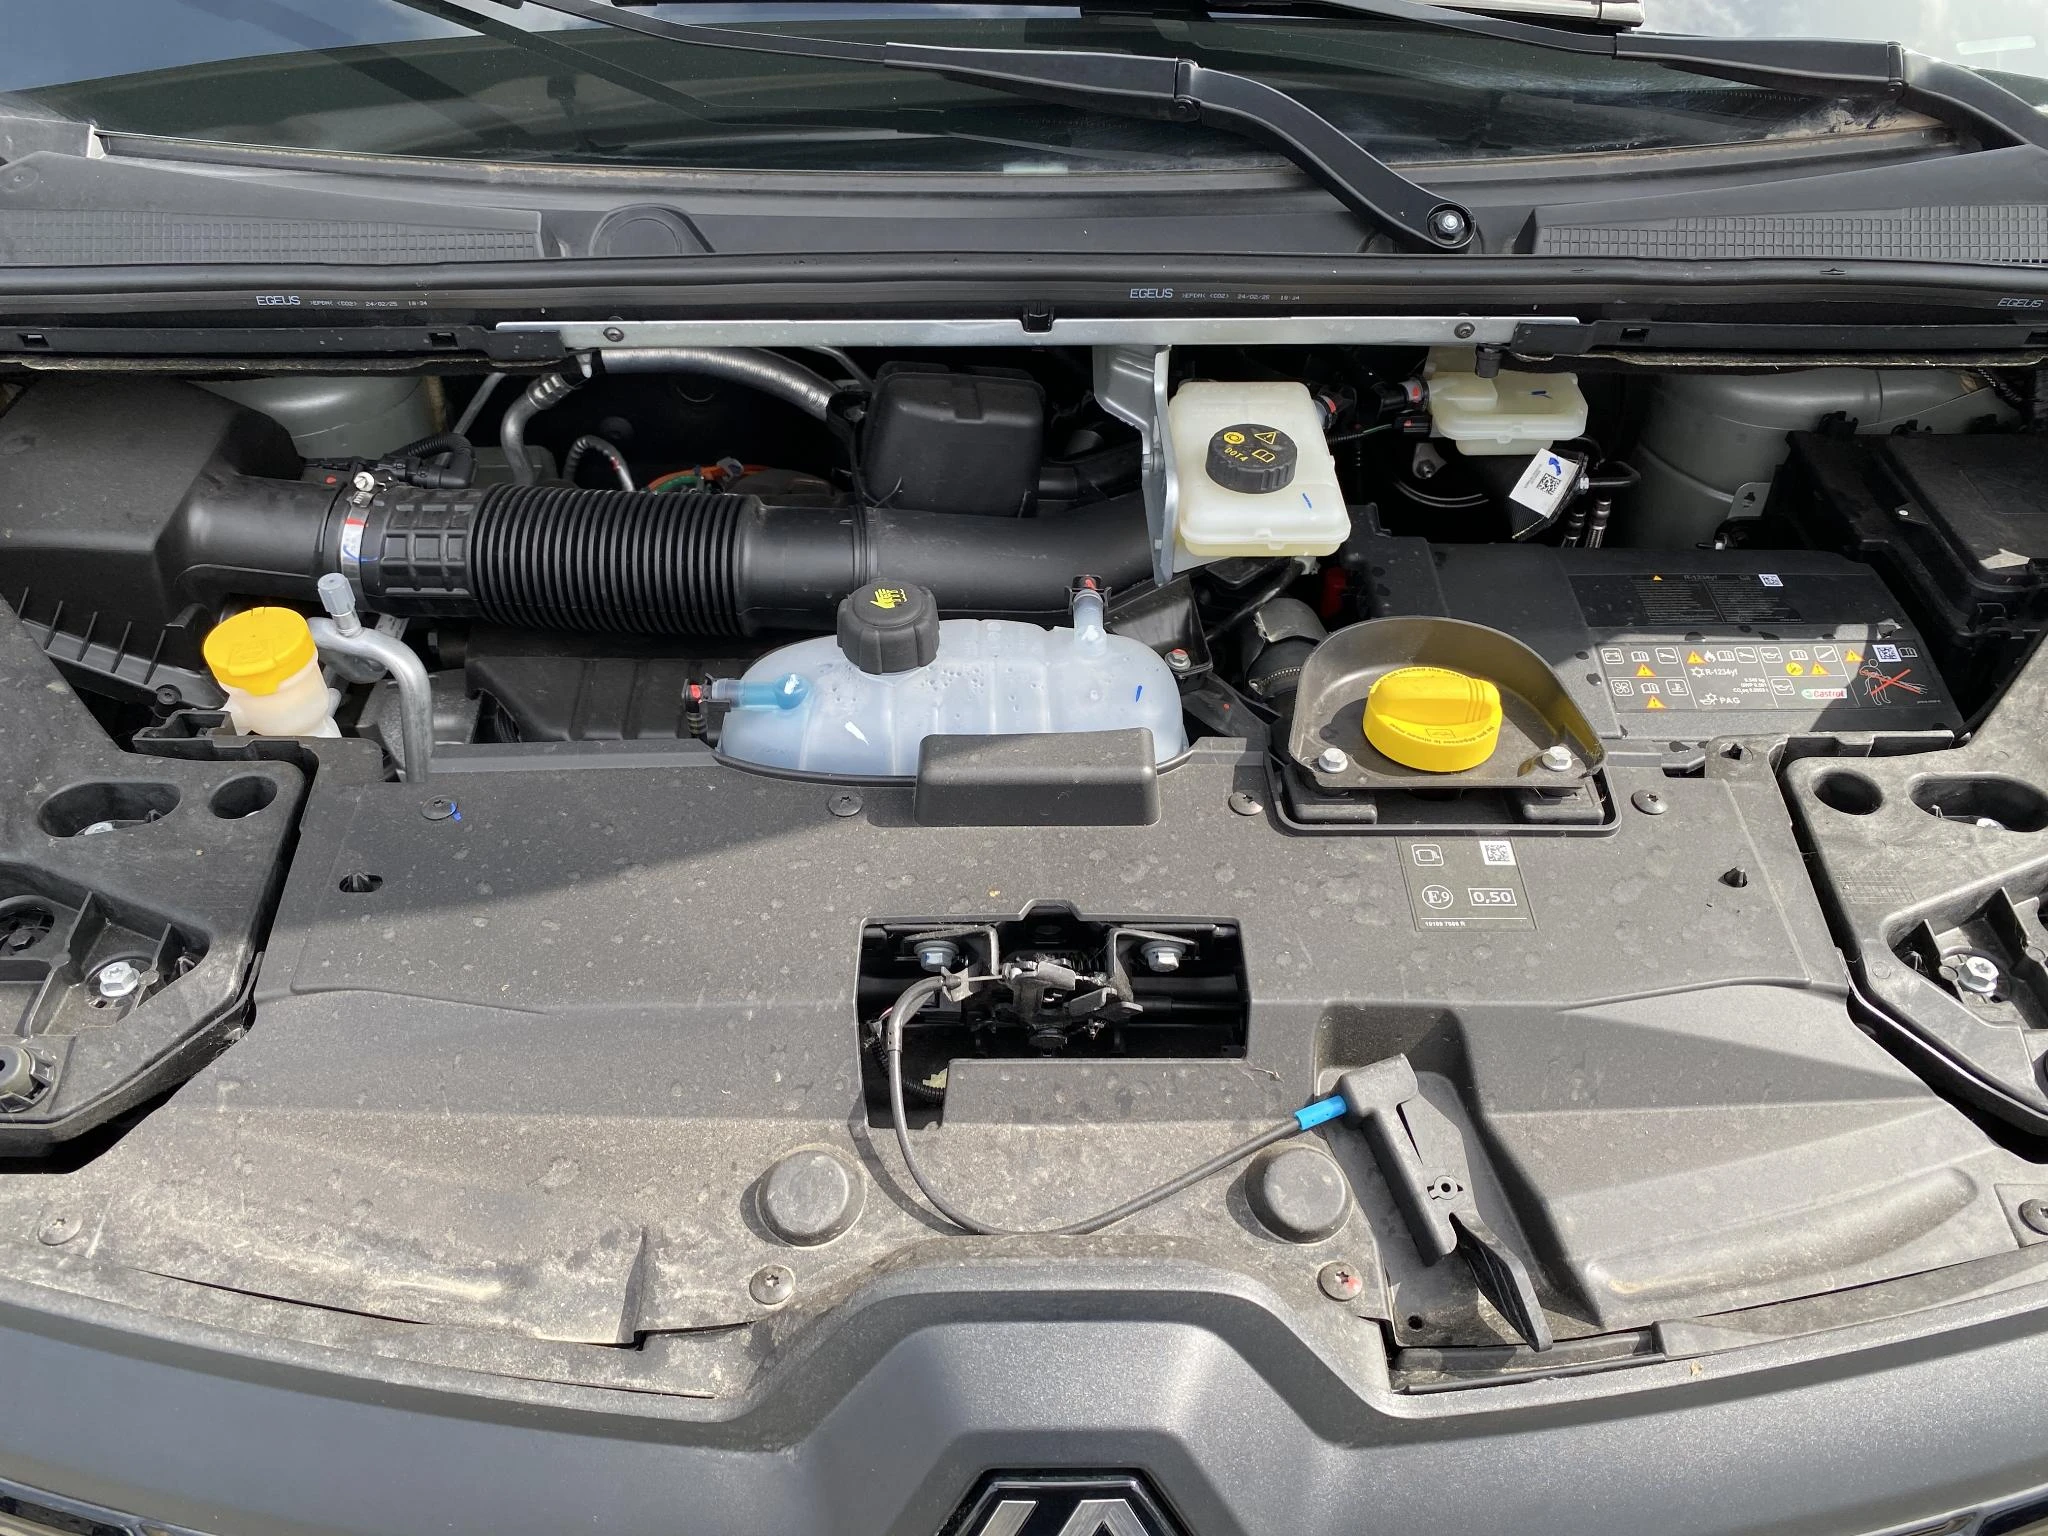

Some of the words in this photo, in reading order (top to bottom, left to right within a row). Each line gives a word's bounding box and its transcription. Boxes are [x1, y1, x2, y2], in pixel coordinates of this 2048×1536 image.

[1130, 288, 1174, 299] EGEUS
[256, 295, 301, 306] EGEUS
[1997, 297, 2044, 308] EGEUS
[1813, 690, 1844, 698] Castrol
[1426, 890, 1450, 904] E9
